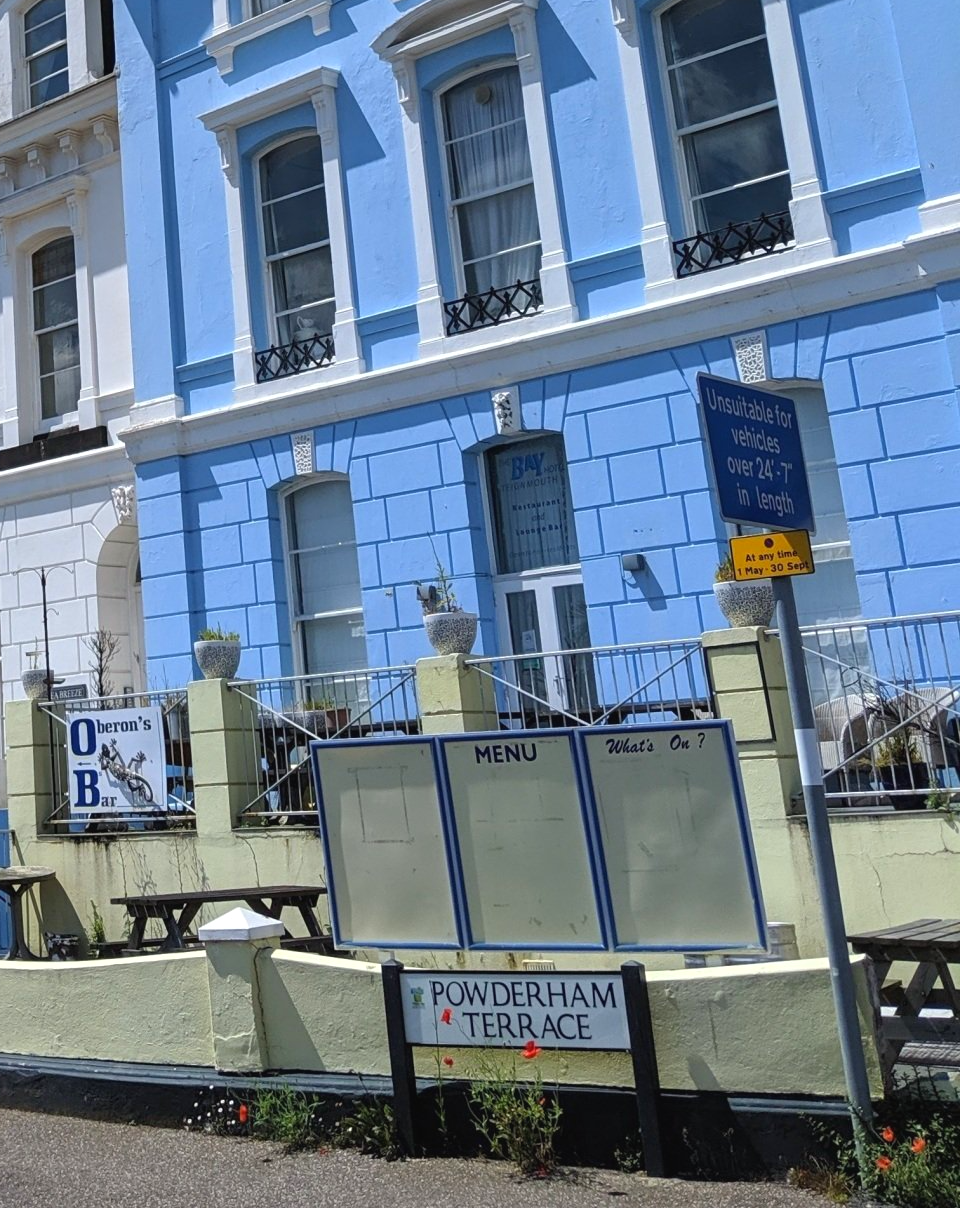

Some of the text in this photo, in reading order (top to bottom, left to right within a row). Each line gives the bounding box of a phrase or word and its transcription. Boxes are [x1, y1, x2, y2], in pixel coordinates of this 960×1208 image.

[706, 387, 792, 429] Unsuitable for
[731, 426, 780, 454] vehicles
[511, 452, 545, 481] BAY
[727, 456, 753, 476] over
[512, 498, 561, 512] Restaurant
[737, 482, 794, 517] in length
[745, 549, 798, 563] At any time
[745, 567, 764, 577] May
[770, 564, 784, 572] 30
[787, 561, 809, 572] Sept
[59, 688, 82, 699] BREEZE
[70, 716, 151, 756] Oberon's
[606, 737, 654, 755] What's
[670, 734, 691, 751] On
[475, 743, 537, 764] MENU
[73, 769, 117, 807] Bar
[432, 981, 617, 1008] POWDERHAM
[462, 1012, 593, 1040] TERRACE
